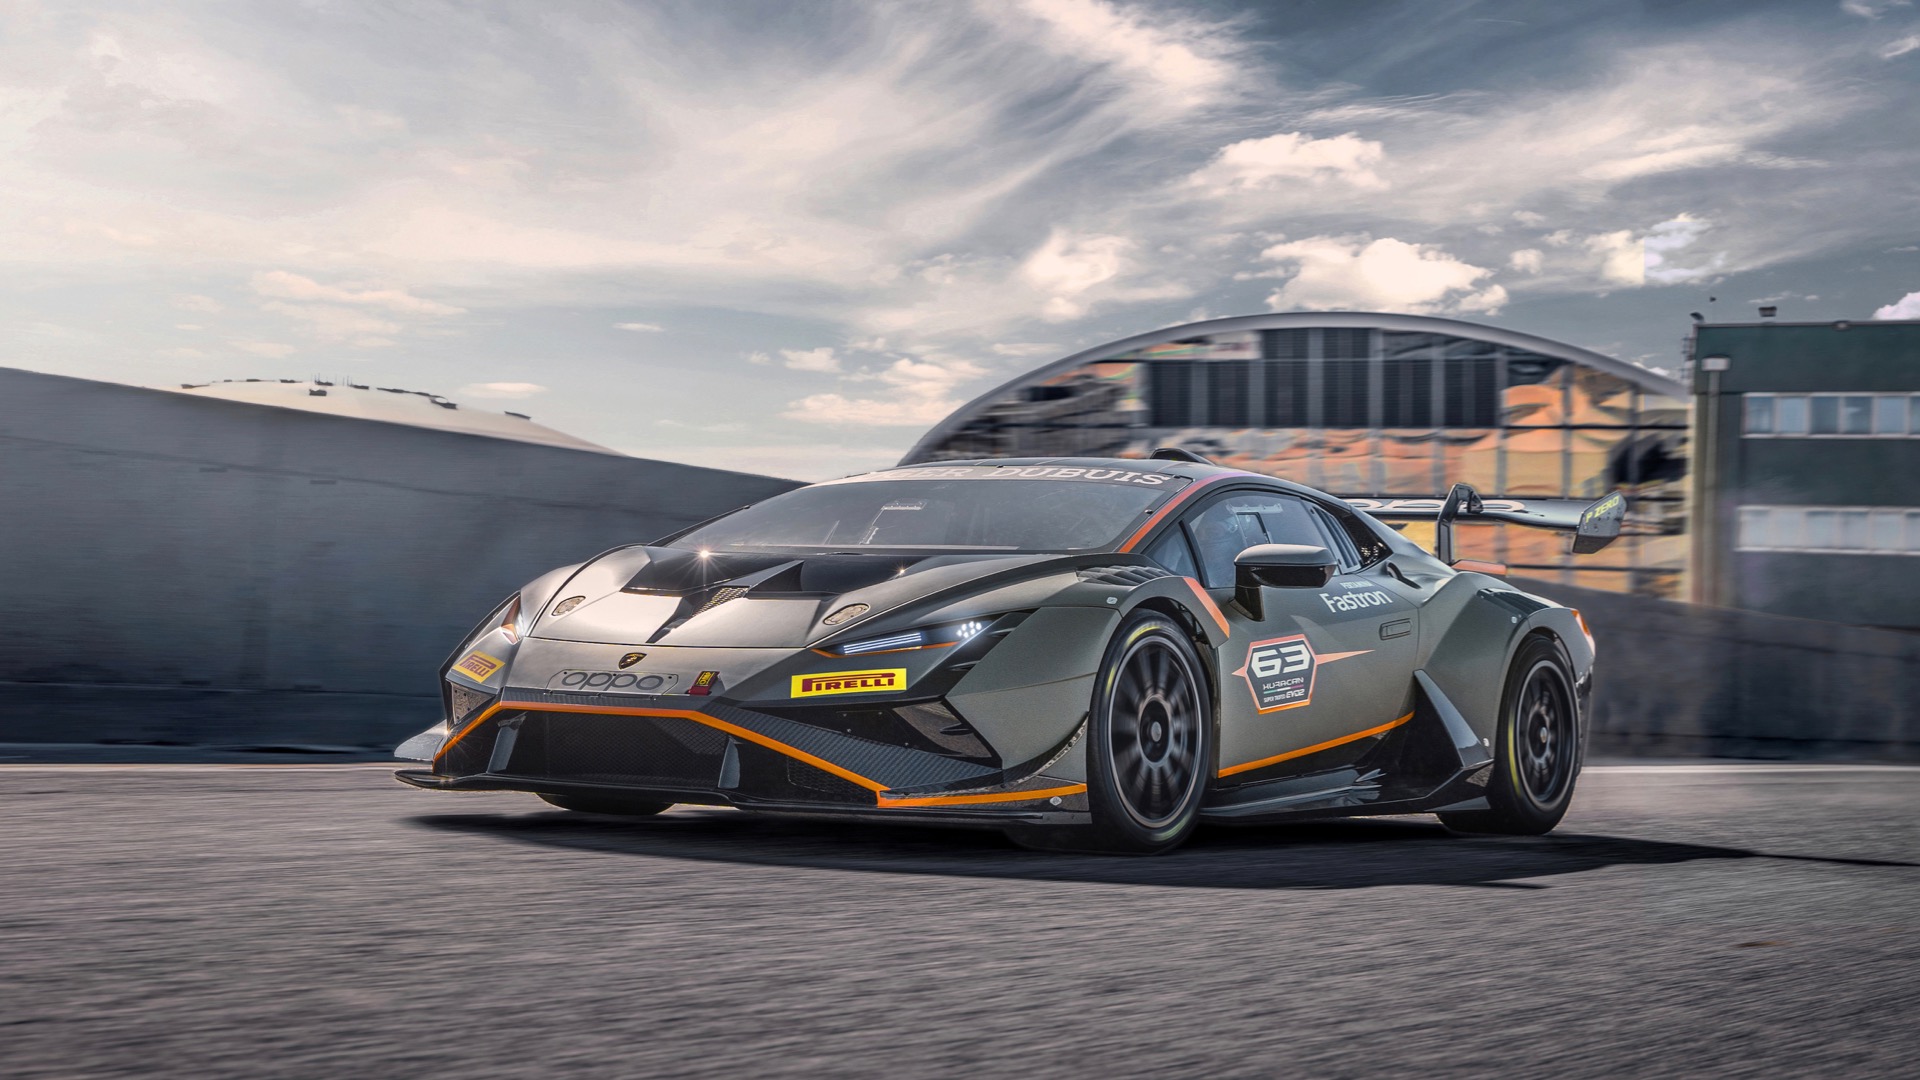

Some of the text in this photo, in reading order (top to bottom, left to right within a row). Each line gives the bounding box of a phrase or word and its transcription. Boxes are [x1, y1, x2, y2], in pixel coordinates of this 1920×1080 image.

[981, 467, 1171, 485] DUBUIS
[1585, 495, 1620, 523] P ZERO
[1319, 590, 1393, 613] Fastron
[459, 653, 497, 678] PIRELLI
[1251, 643, 1311, 678] 63
[802, 672, 896, 693] PIRELLI
[1262, 677, 1304, 690] HURACAN
